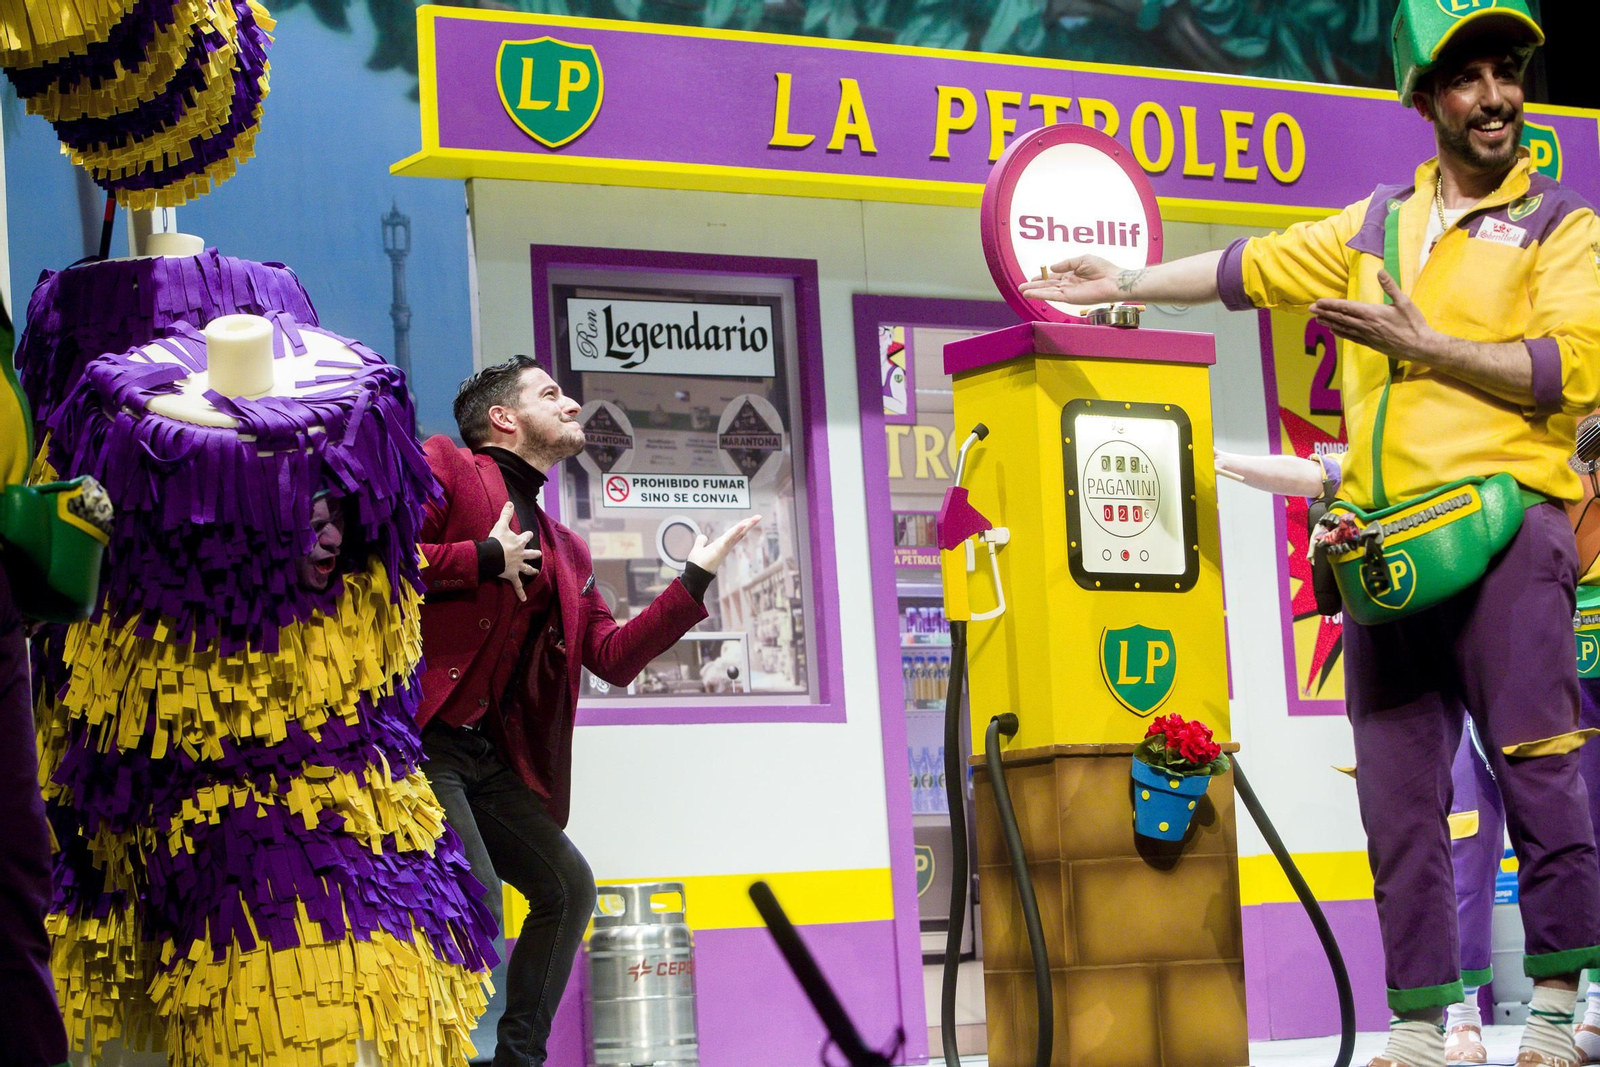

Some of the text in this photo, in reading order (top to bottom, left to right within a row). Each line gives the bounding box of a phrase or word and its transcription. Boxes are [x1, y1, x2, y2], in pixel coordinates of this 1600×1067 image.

[515, 57, 591, 112] LP
[768, 72, 878, 154] LA
[1018, 214, 1142, 247] Shellif
[575, 304, 768, 369] Ron Legendario
[721, 435, 779, 447] MARANTONA
[885, 425, 956, 479] TR
[632, 478, 745, 489] PROHIBIDO FUMAR
[641, 493, 739, 503] SINO SE CONVIA
[1087, 478, 1156, 496] PAGANINI
[1116, 640, 1170, 685] LP
